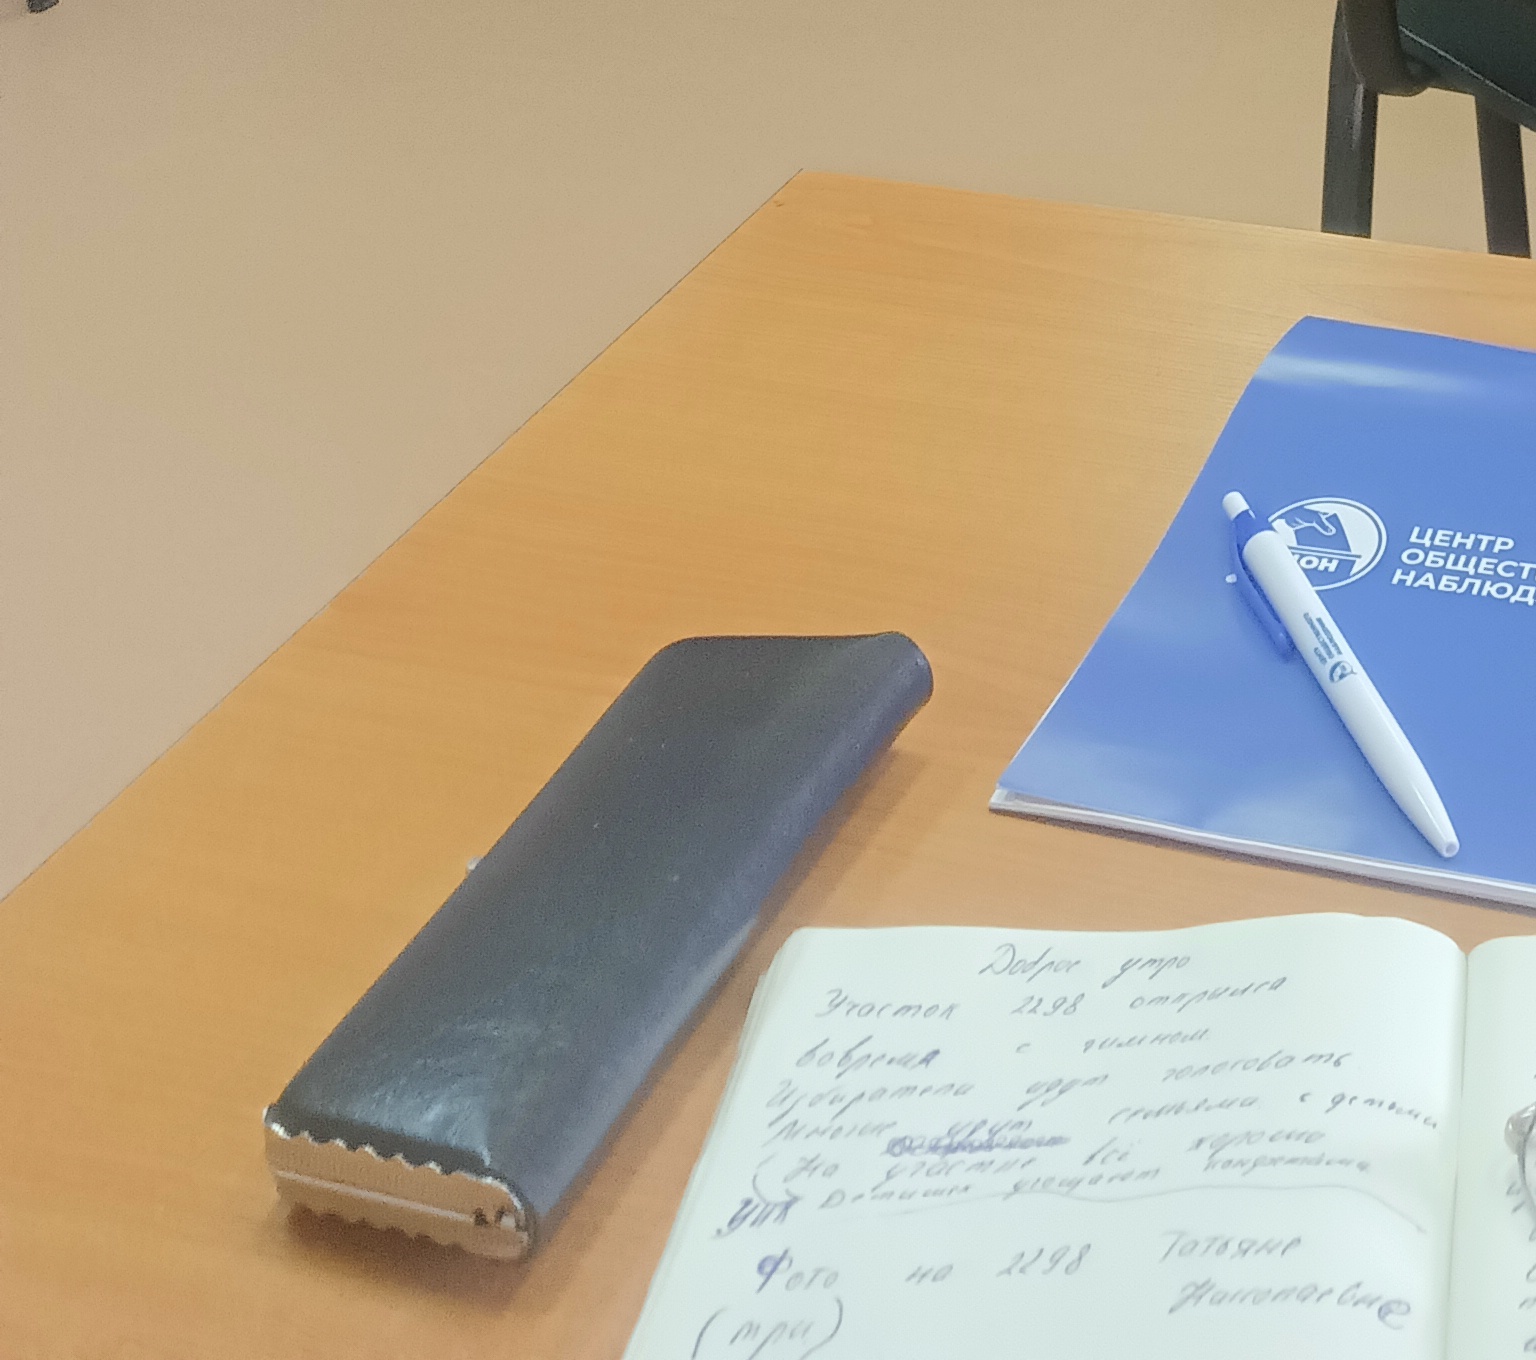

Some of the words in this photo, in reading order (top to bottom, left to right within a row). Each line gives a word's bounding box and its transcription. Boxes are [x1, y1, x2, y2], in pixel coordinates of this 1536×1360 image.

[1408, 525, 1515, 554] ЦЕНТР
[1010, 992, 1086, 1018] 2298
[996, 1243, 1092, 1278] 2298
